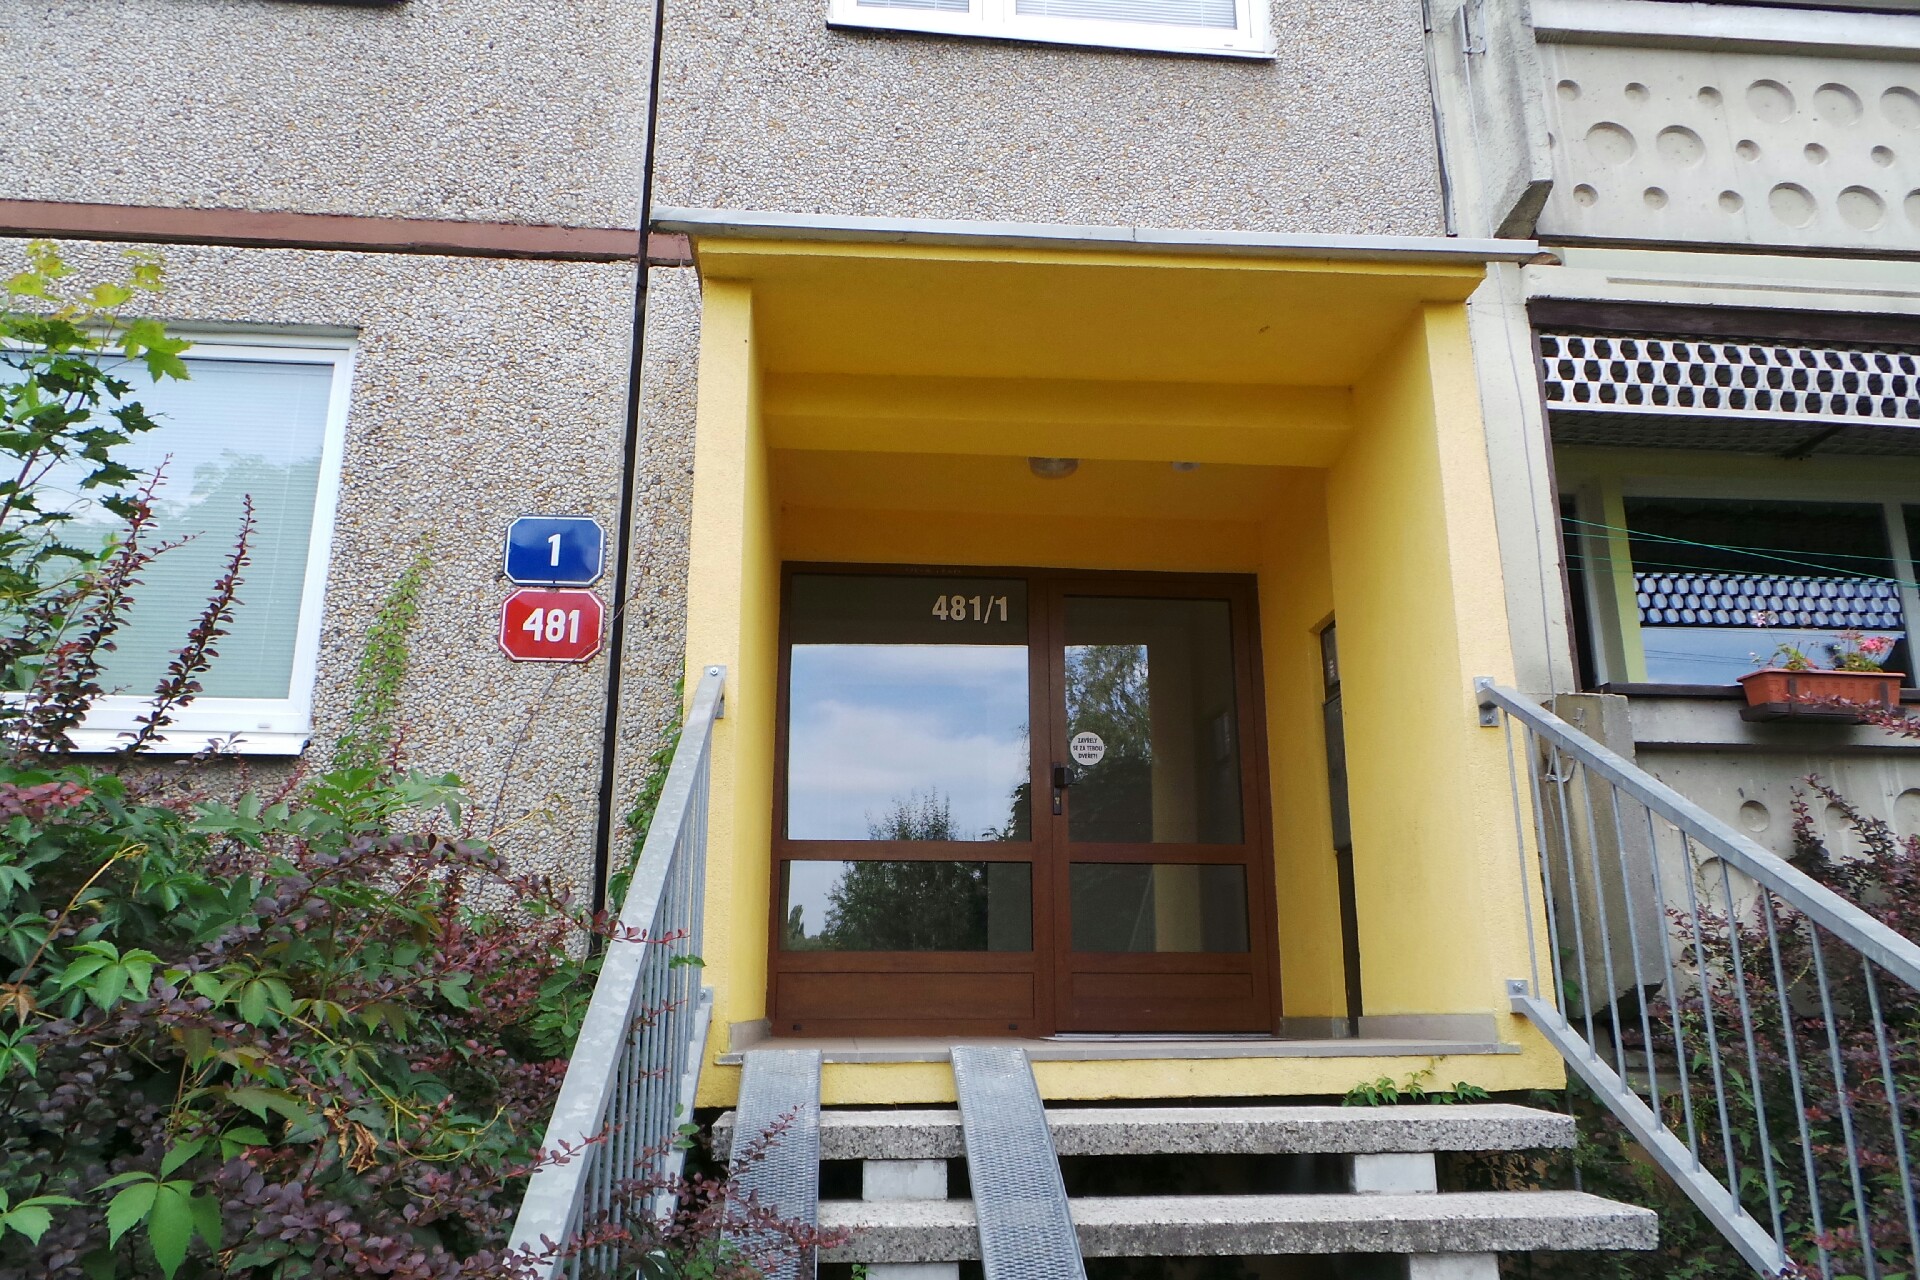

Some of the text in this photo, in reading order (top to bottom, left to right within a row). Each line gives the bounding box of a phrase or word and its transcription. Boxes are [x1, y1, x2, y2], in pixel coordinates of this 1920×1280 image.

[547, 533, 561, 567] 1
[522, 608, 580, 643] 481
[932, 595, 1008, 624] 481/1
